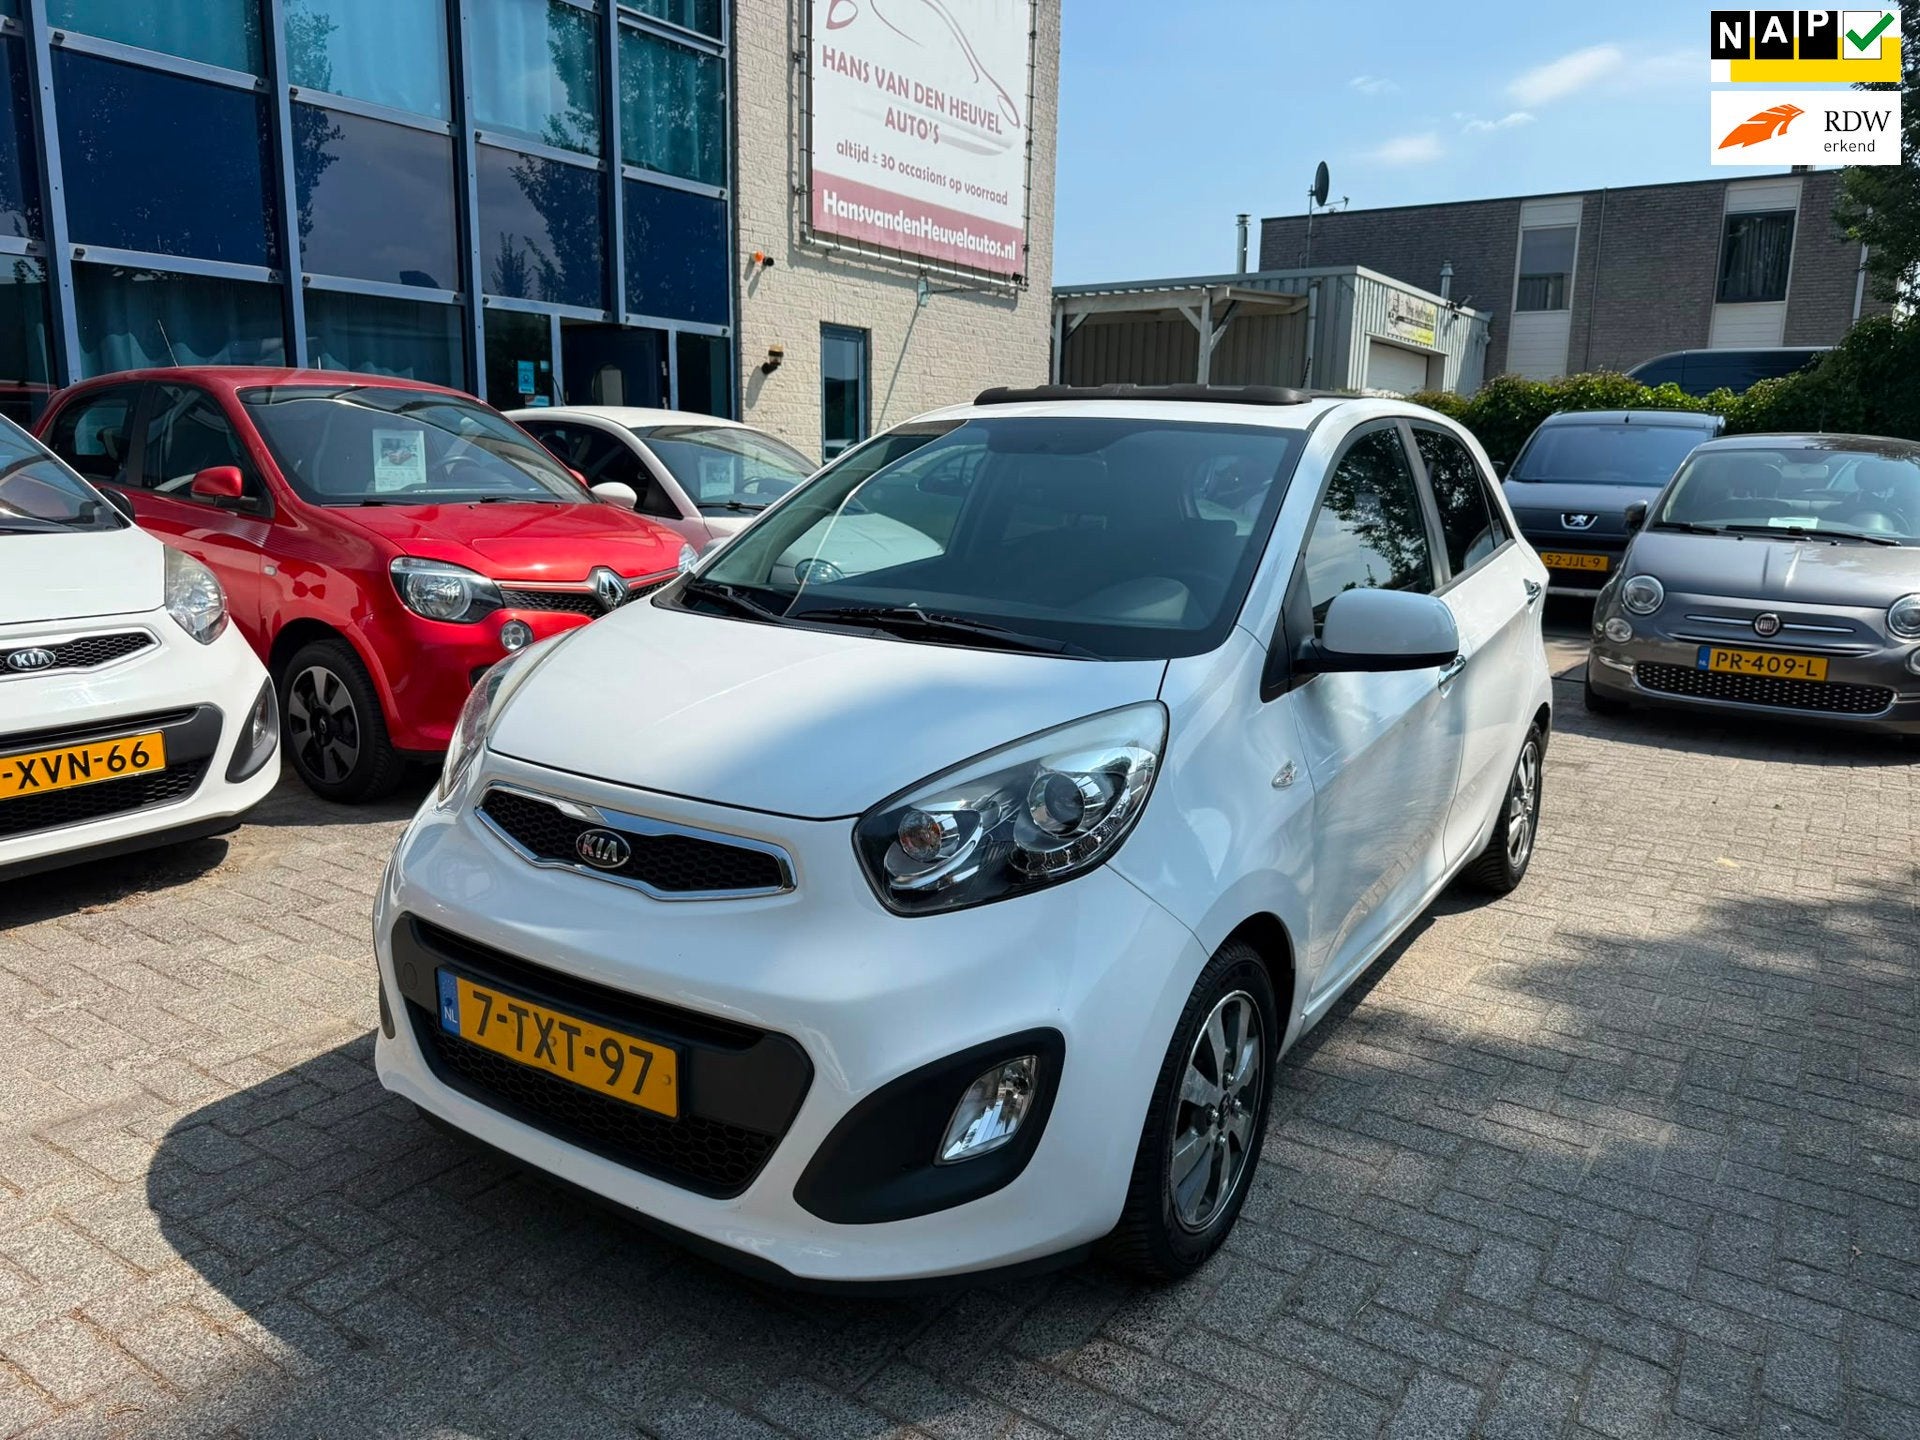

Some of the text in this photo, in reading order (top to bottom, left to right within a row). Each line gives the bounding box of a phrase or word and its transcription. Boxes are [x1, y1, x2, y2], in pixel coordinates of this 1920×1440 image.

[822, 44, 1003, 135] HANS VAN DEN HEUVEL
[884, 107, 940, 144] AUTO'S
[836, 139, 869, 164] altijd
[880, 153, 895, 171] 30
[898, 162, 946, 187] occasions
[949, 177, 962, 194] op
[964, 185, 1008, 206] voorraad
[822, 188, 1016, 261] HansvandenHeuvelautos.nl
[14, 652, 51, 667] KIA
[1715, 652, 1818, 677] PR-409-L
[582, 834, 618, 862] KIA
[444, 1006, 458, 1024] NL
[473, 990, 654, 1096] 7-TXT-97
